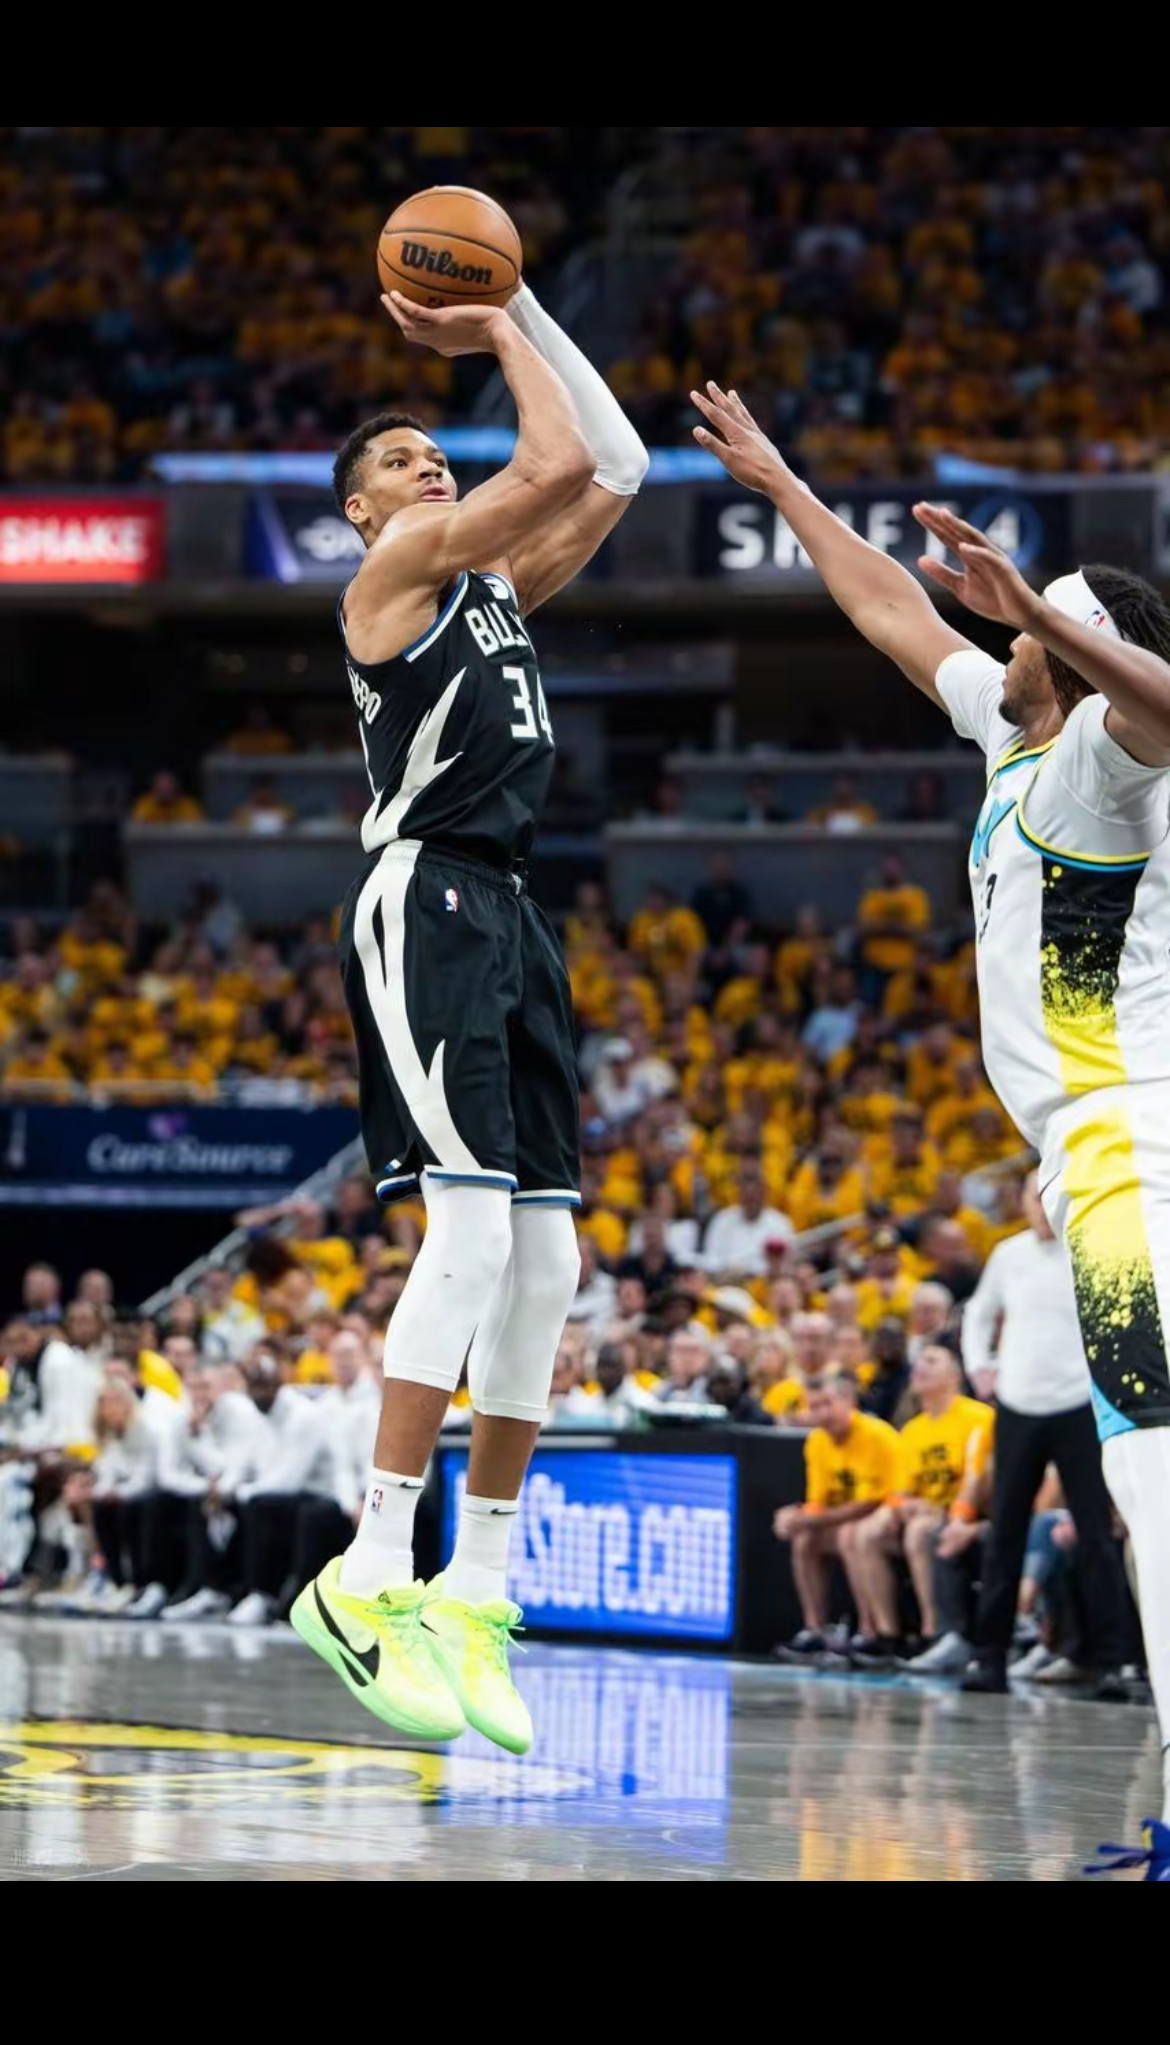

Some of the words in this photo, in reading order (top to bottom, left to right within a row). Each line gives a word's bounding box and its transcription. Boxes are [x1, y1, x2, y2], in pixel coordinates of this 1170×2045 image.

[401, 241, 493, 285] Wilson
[1, 516, 147, 563] SHAKE
[502, 666, 556, 749] 34
[87, 1133, 293, 1173] CareSource
